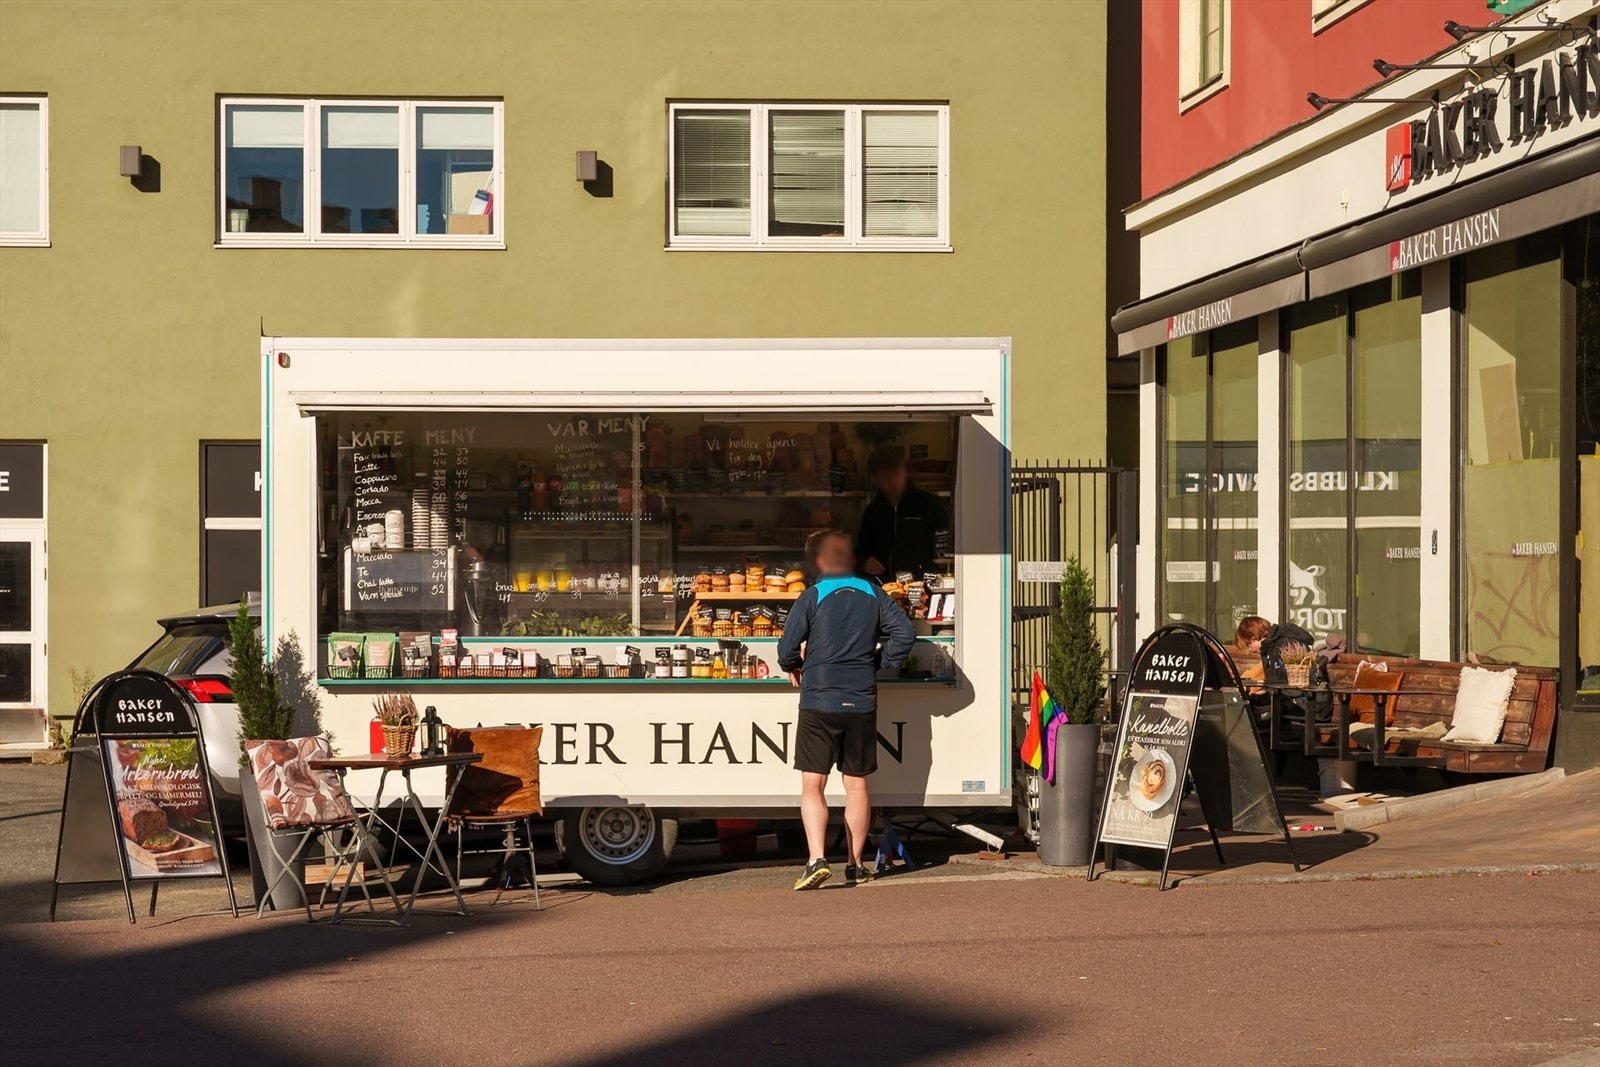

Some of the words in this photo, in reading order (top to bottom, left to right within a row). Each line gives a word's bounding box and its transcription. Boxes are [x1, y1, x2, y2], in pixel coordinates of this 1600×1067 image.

[1411, 88, 1503, 186] BAKER
[1399, 230, 1438, 269] BAKER
[1442, 208, 1500, 256] HANSEN
[1173, 310, 1197, 338] BAKER
[1198, 298, 1232, 330] HANSEN
[351, 430, 405, 447] KAFFE
[426, 427, 477, 446] MENY
[705, 438, 720, 452] Vi
[354, 463, 380, 474] Latte
[433, 459, 446, 468] 44
[456, 457, 469, 466] 50
[354, 485, 389, 496] Cortado
[356, 498, 382, 508] Mocca
[357, 510, 387, 521] Espress
[1516, 543, 1533, 555] BAKER
[1533, 541, 1558, 555] HANSEN
[357, 566, 370, 577] Te
[431, 559, 447, 569] 34
[357, 579, 377, 589] Chai
[431, 571, 447, 582] 44
[495, 581, 514, 592] brus
[430, 584, 445, 596] 52
[534, 592, 548, 602] 50
[571, 590, 582, 600] 39
[641, 589, 654, 597] 22
[1130, 714, 1189, 736] Kanelbolle
[649, 721, 907, 765] HANN
